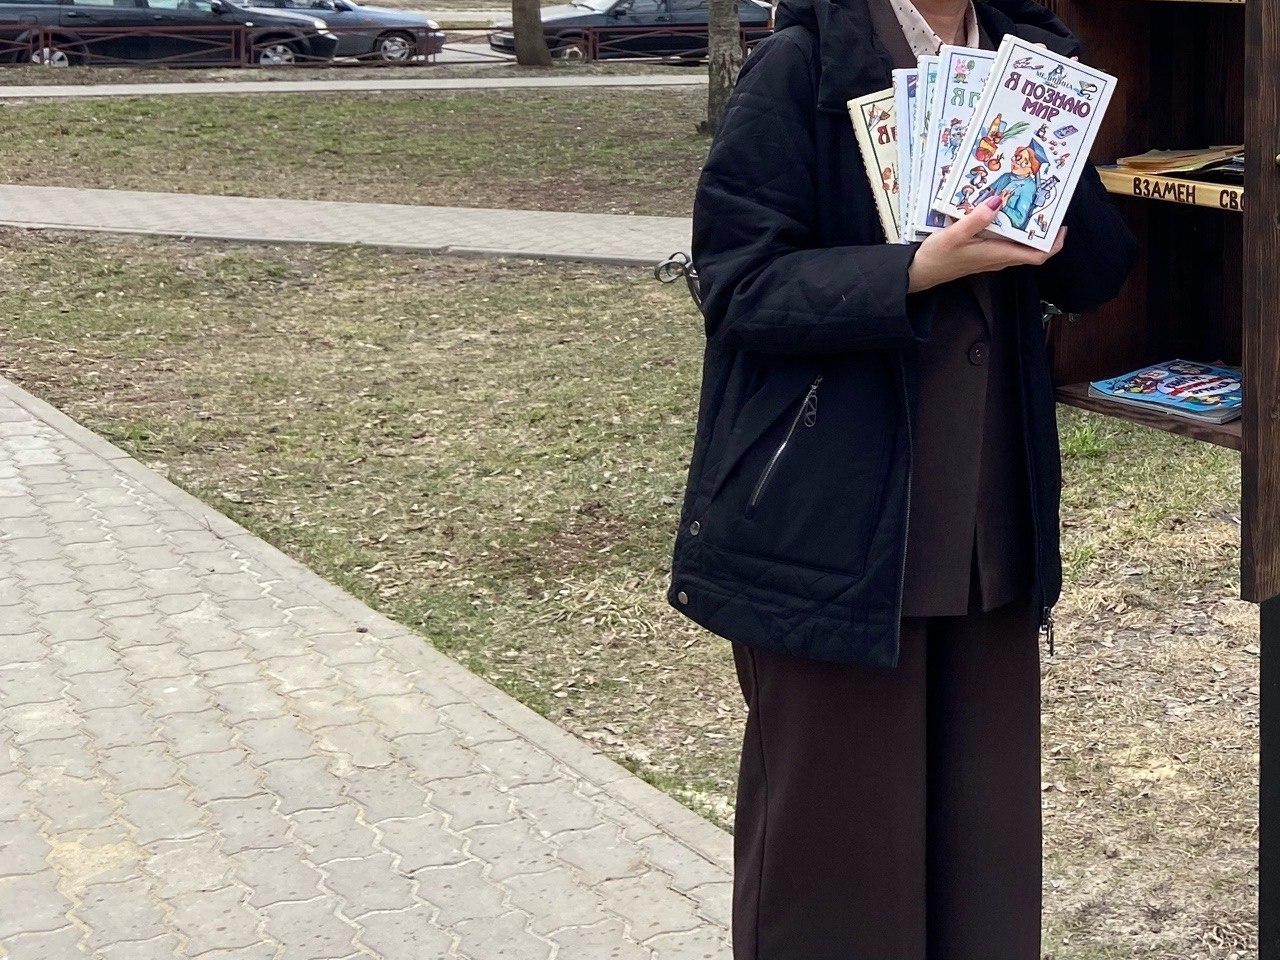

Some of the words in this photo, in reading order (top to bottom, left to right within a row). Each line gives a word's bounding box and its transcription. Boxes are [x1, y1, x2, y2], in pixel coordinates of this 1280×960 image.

[951, 87, 965, 107] Я
[1004, 71, 1021, 90] Я
[1021, 79, 1091, 118] ПОЗНАЮ
[1021, 96, 1060, 122] МИР
[877, 125, 891, 145] Я
[1133, 177, 1196, 204] ВЗАМЕН
